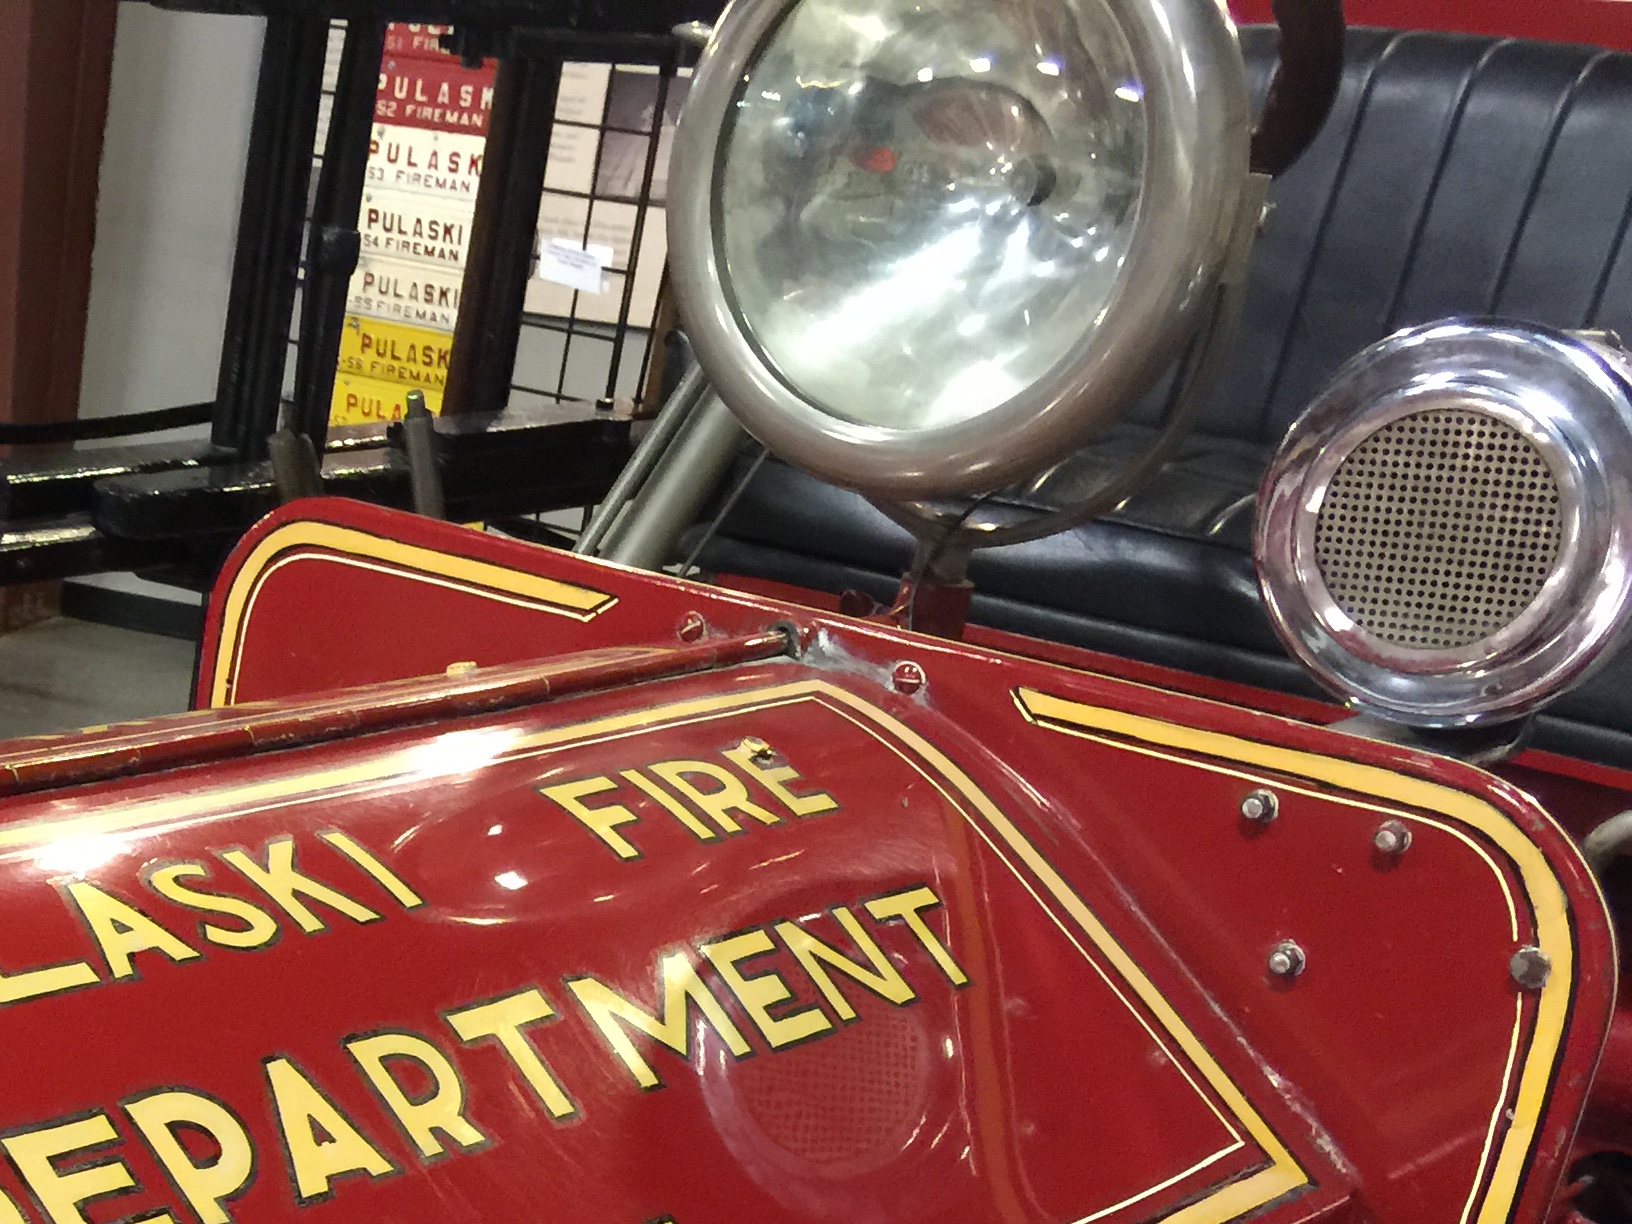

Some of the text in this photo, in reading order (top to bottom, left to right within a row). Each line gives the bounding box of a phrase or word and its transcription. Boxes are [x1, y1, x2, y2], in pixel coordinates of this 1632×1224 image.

[405, 104, 484, 128] FIREMAN
[394, 169, 471, 193] FIREMAN
[367, 207, 464, 246] PULASKI
[363, 233, 460, 262] 54 FIREMAN
[362, 271, 458, 310] PULASKI
[376, 300, 451, 324] FIREMAN
[369, 360, 446, 387] FIREMAN
[538, 737, 841, 861] FIRE
